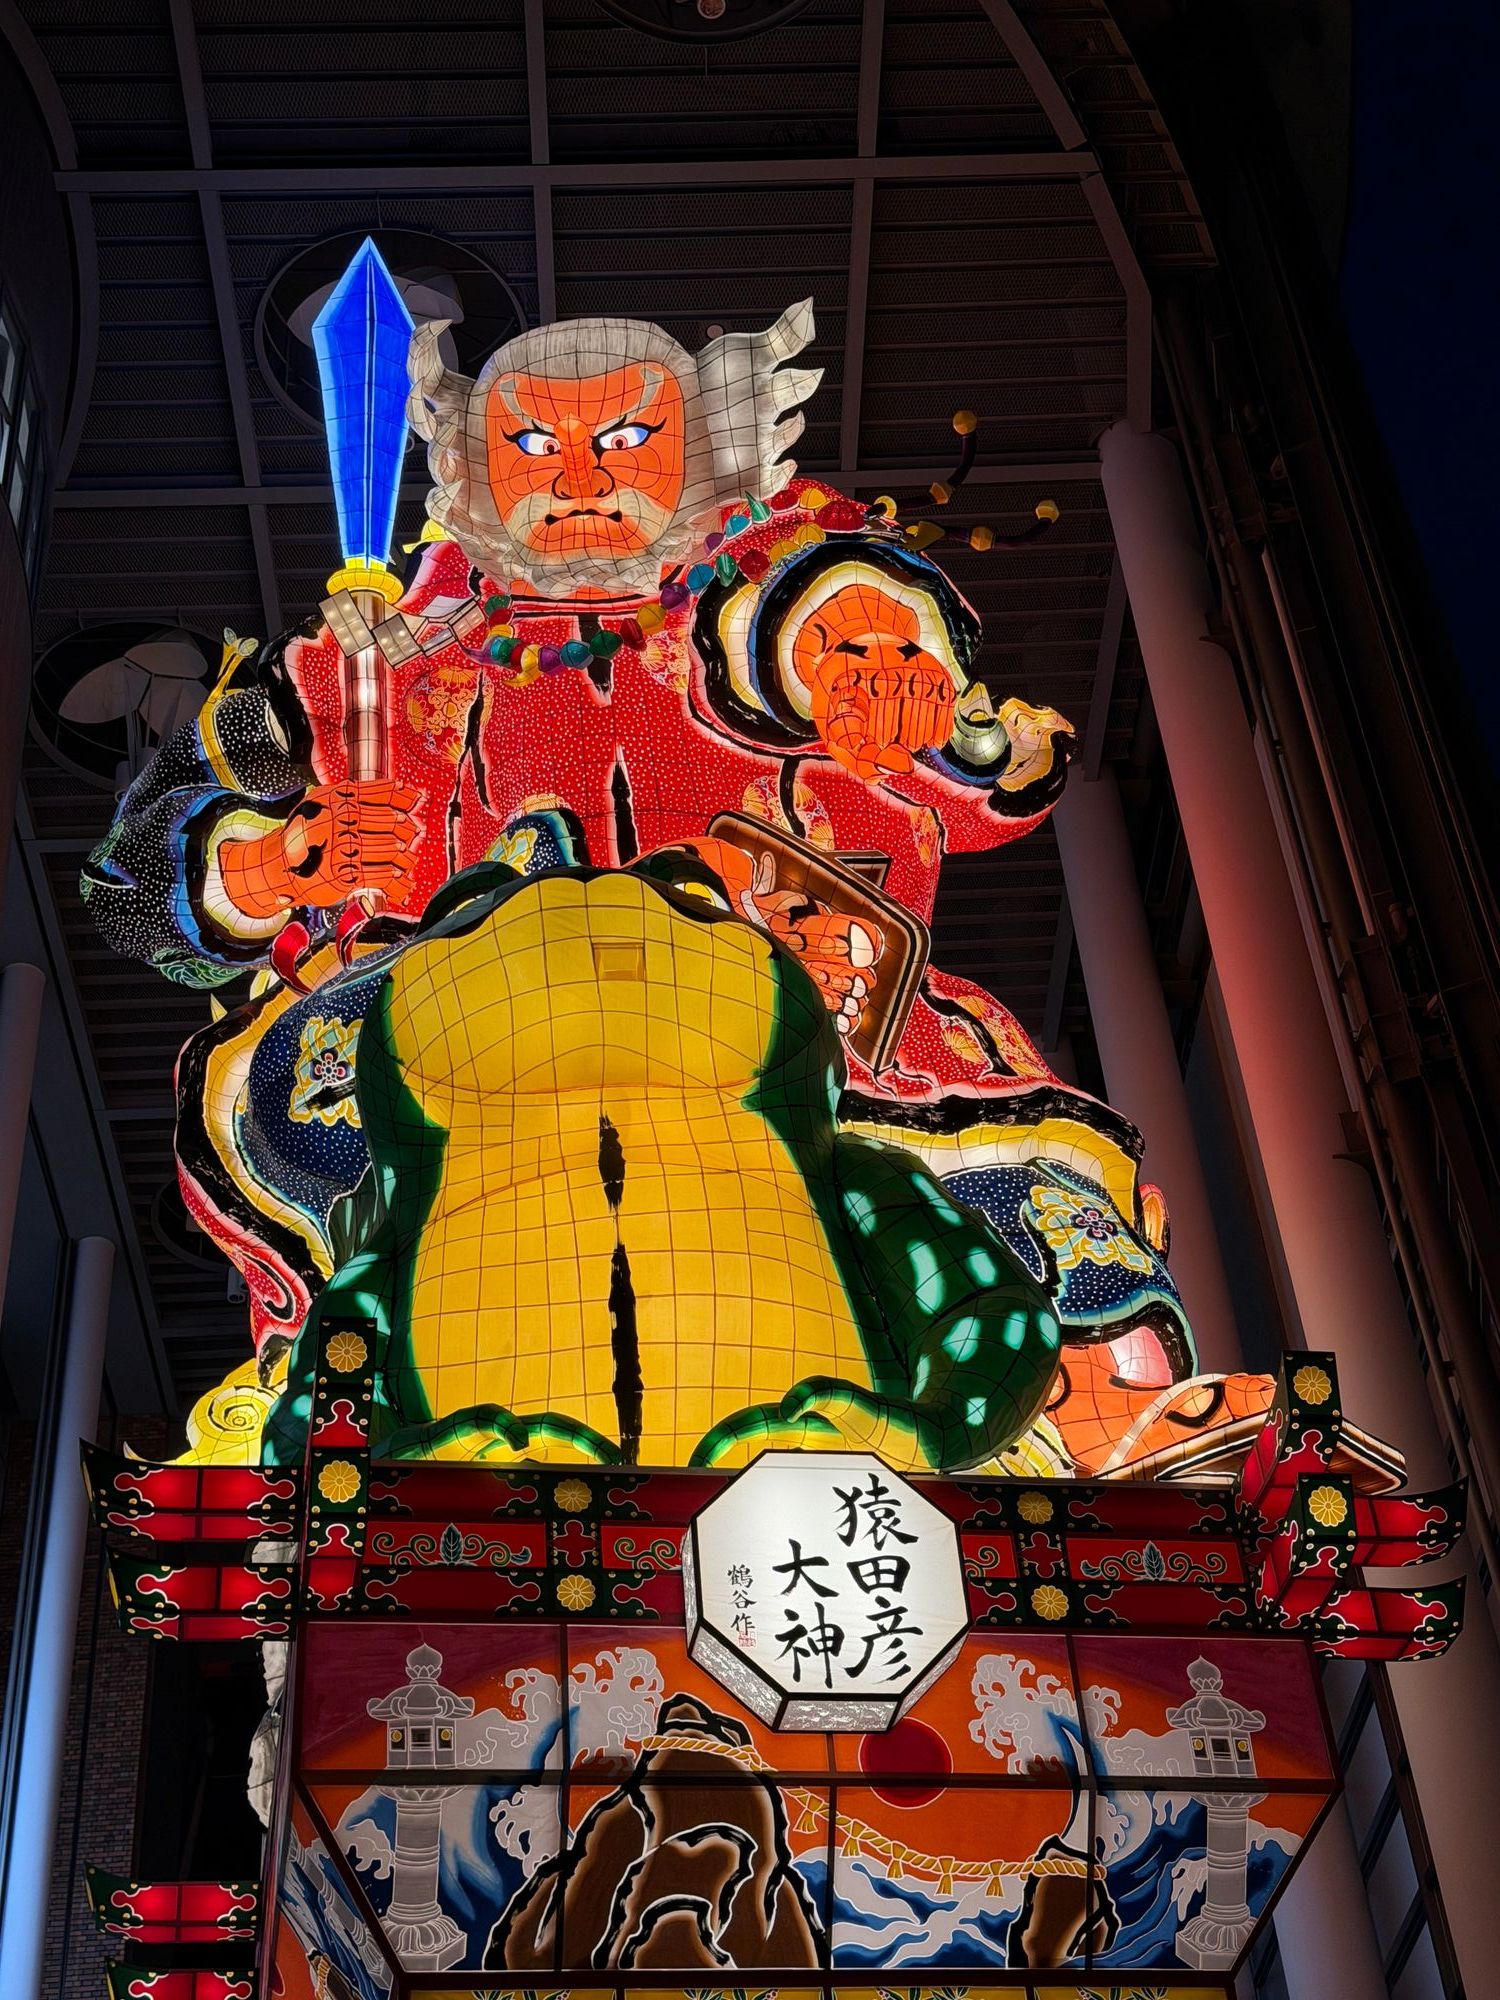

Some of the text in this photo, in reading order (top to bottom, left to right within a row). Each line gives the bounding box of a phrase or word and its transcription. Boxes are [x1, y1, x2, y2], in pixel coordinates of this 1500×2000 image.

[771, 1538, 845, 1689] 大神
[832, 1473, 924, 1685] 猿田彦
